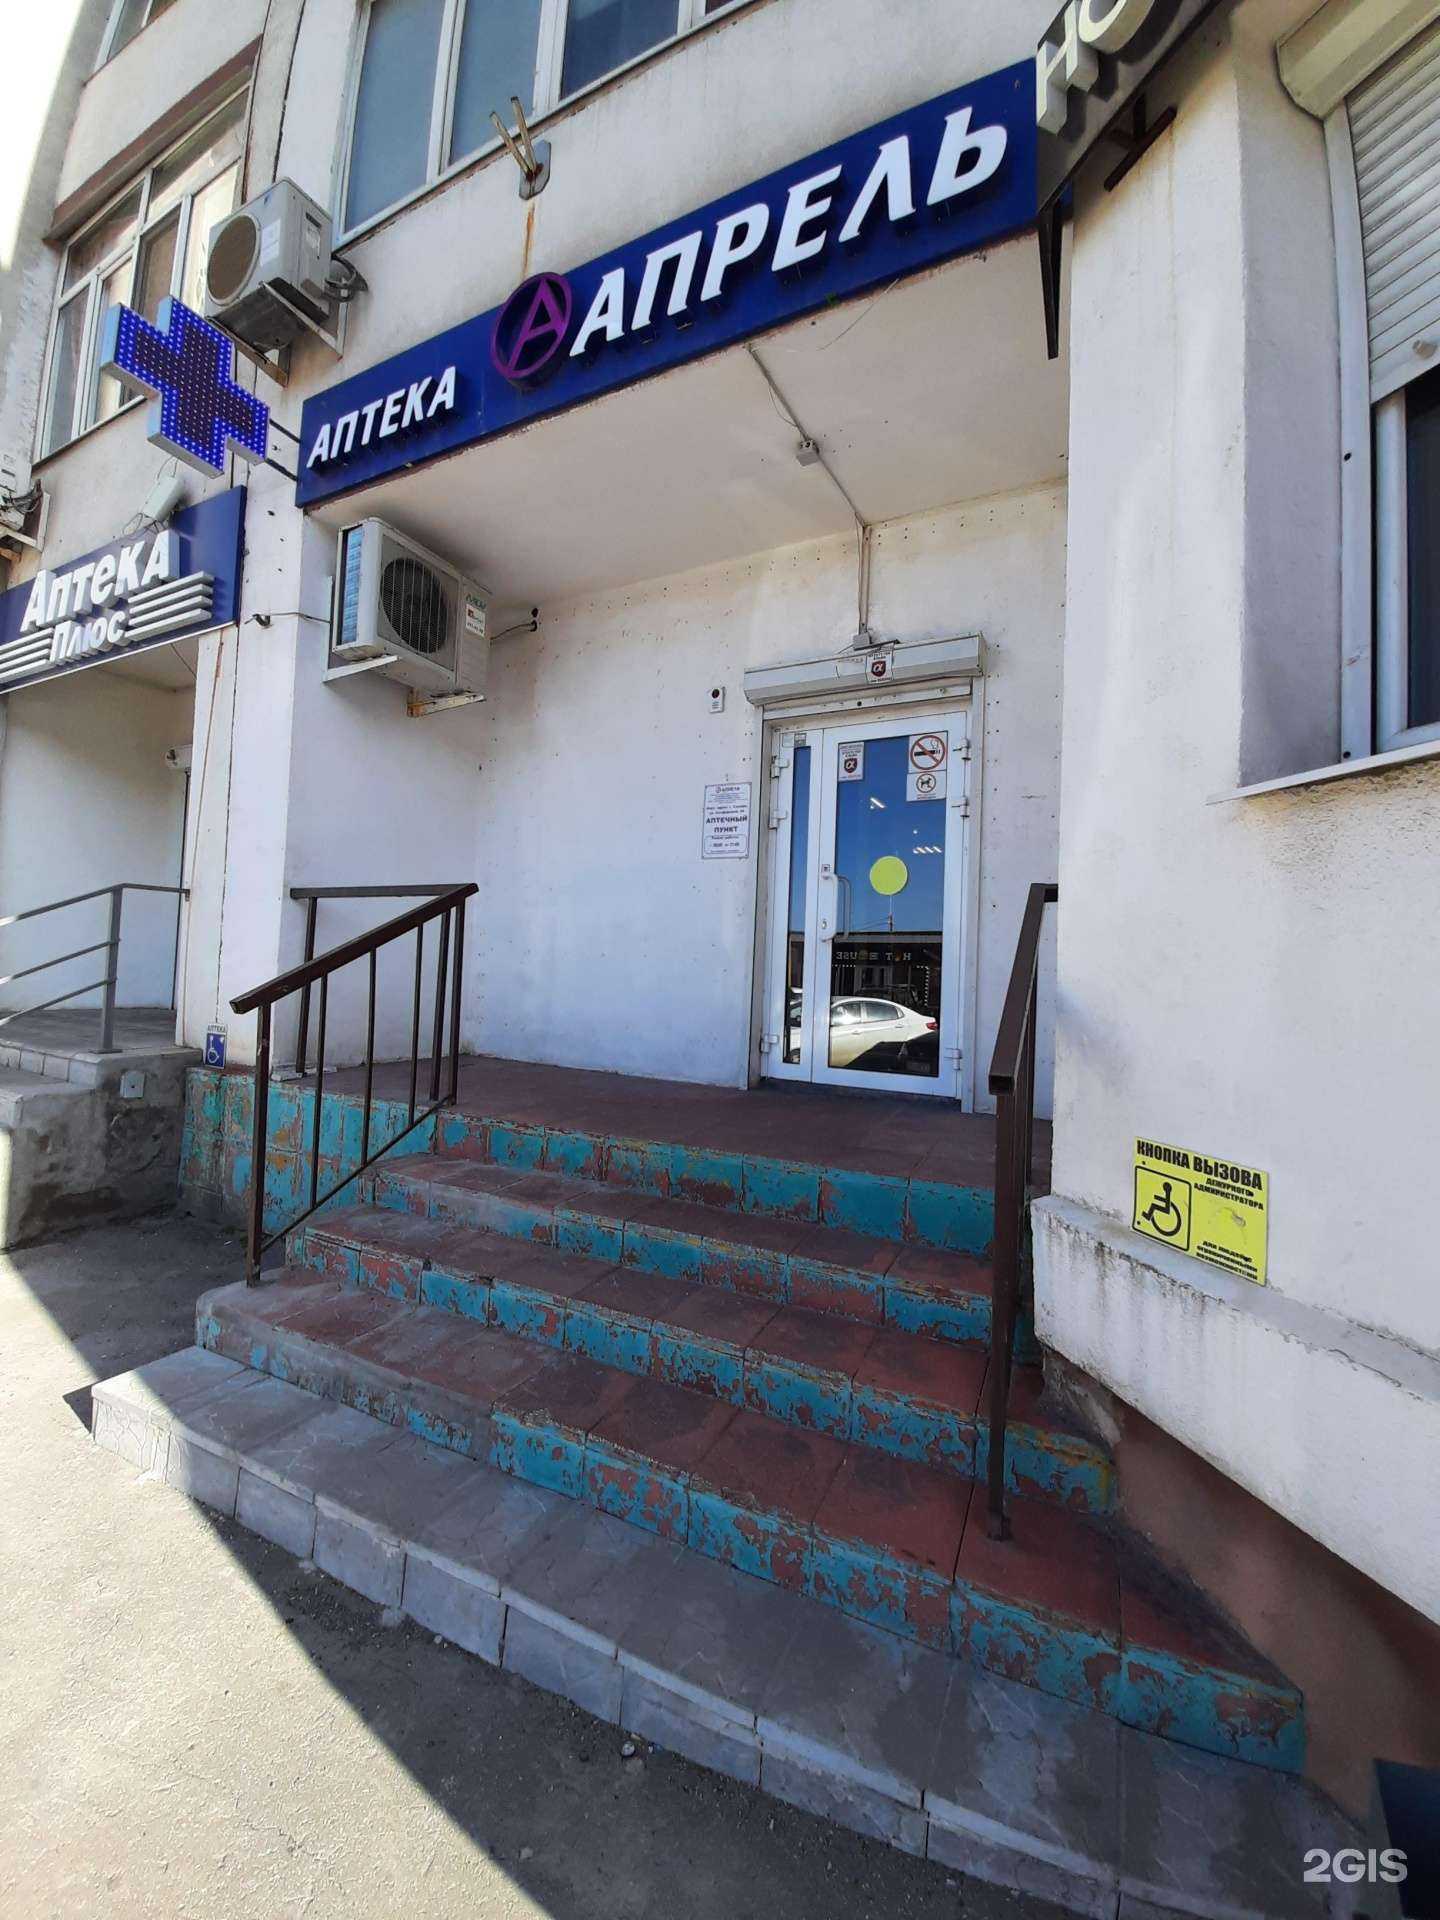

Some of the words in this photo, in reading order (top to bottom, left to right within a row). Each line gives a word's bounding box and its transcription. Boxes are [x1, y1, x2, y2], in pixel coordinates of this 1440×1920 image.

[306, 366, 456, 468] АПТЕКА
[569, 106, 1008, 357] АПРЕЛЬ
[706, 815, 747, 824] АПТЕЧНЫЙ
[1137, 1140, 1190, 1169] КНОПКА
[1193, 1155, 1263, 1190] ВЫЗОВА
